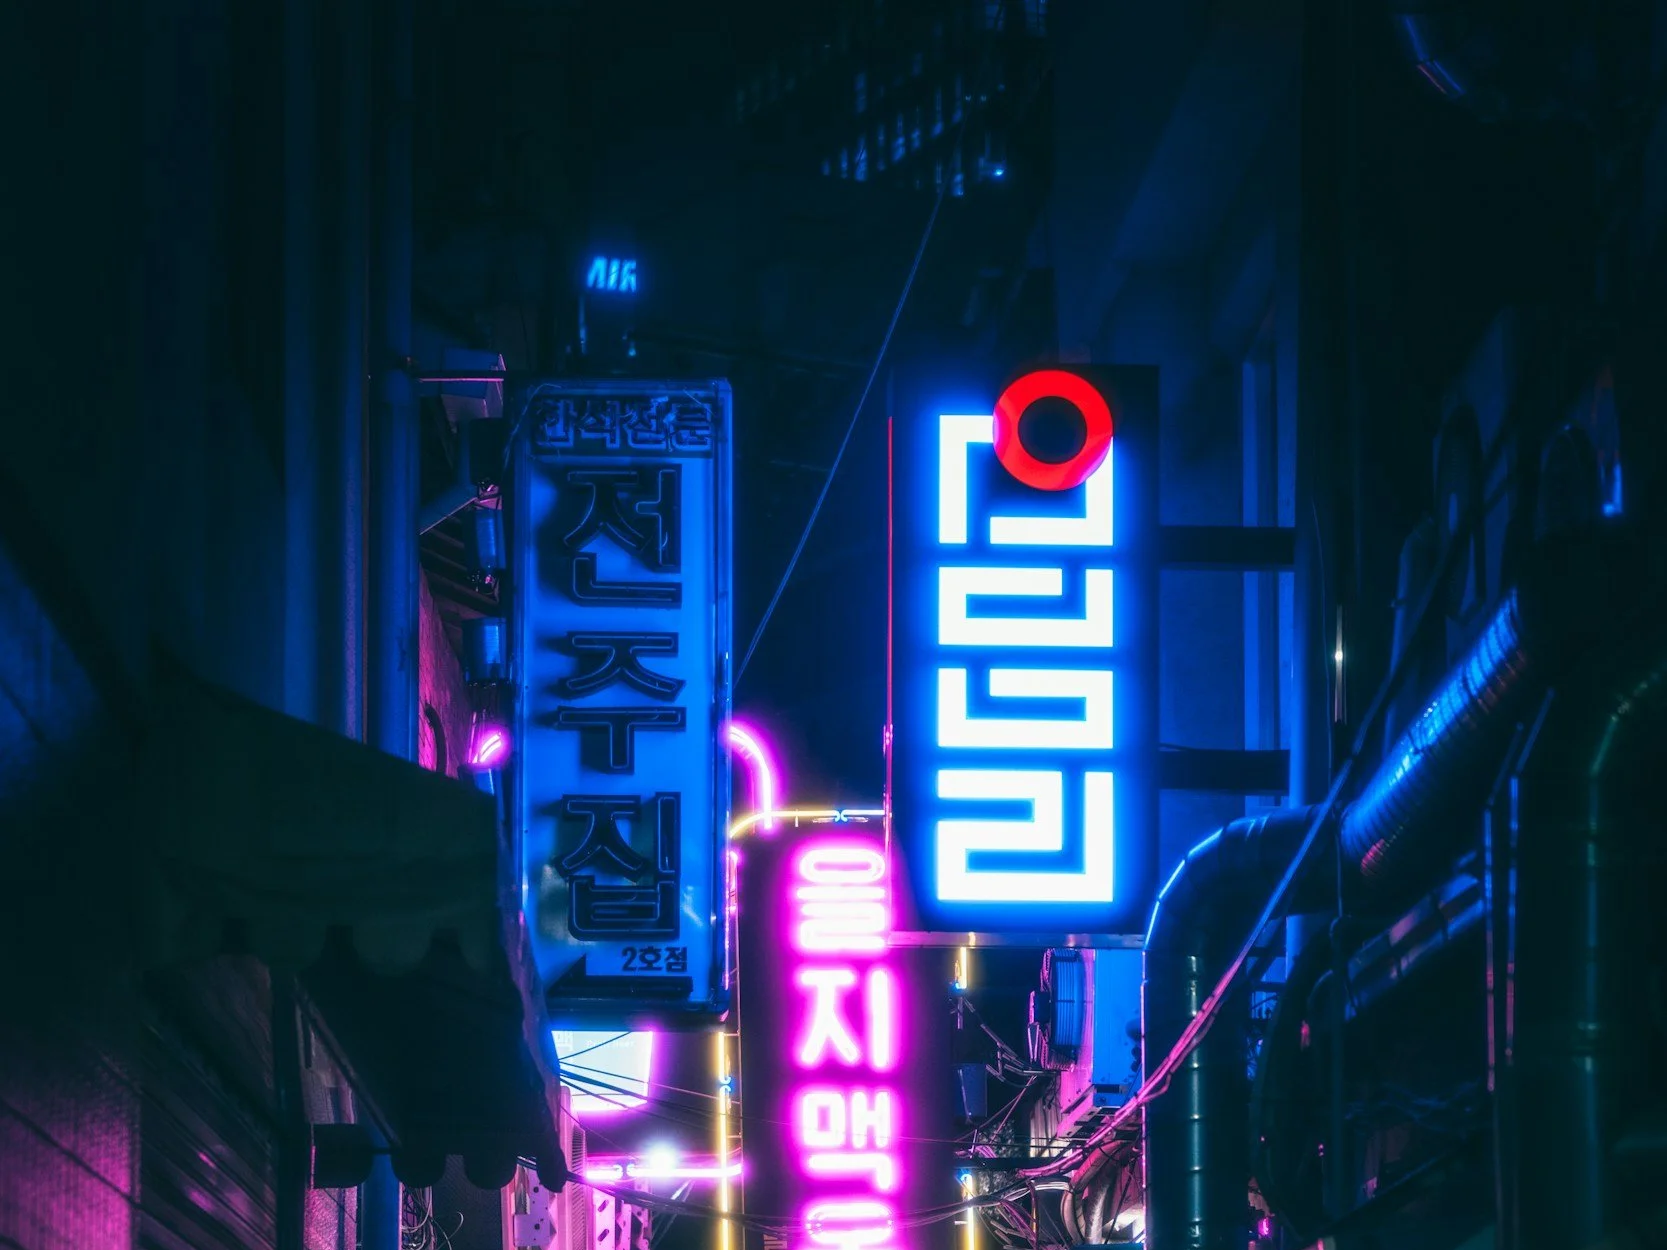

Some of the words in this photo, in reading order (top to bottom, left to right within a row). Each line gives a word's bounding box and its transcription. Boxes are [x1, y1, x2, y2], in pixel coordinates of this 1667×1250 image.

[536, 397, 714, 450] 한식전문
[556, 463, 688, 941] 전주집
[622, 946, 687, 972] 2호점
